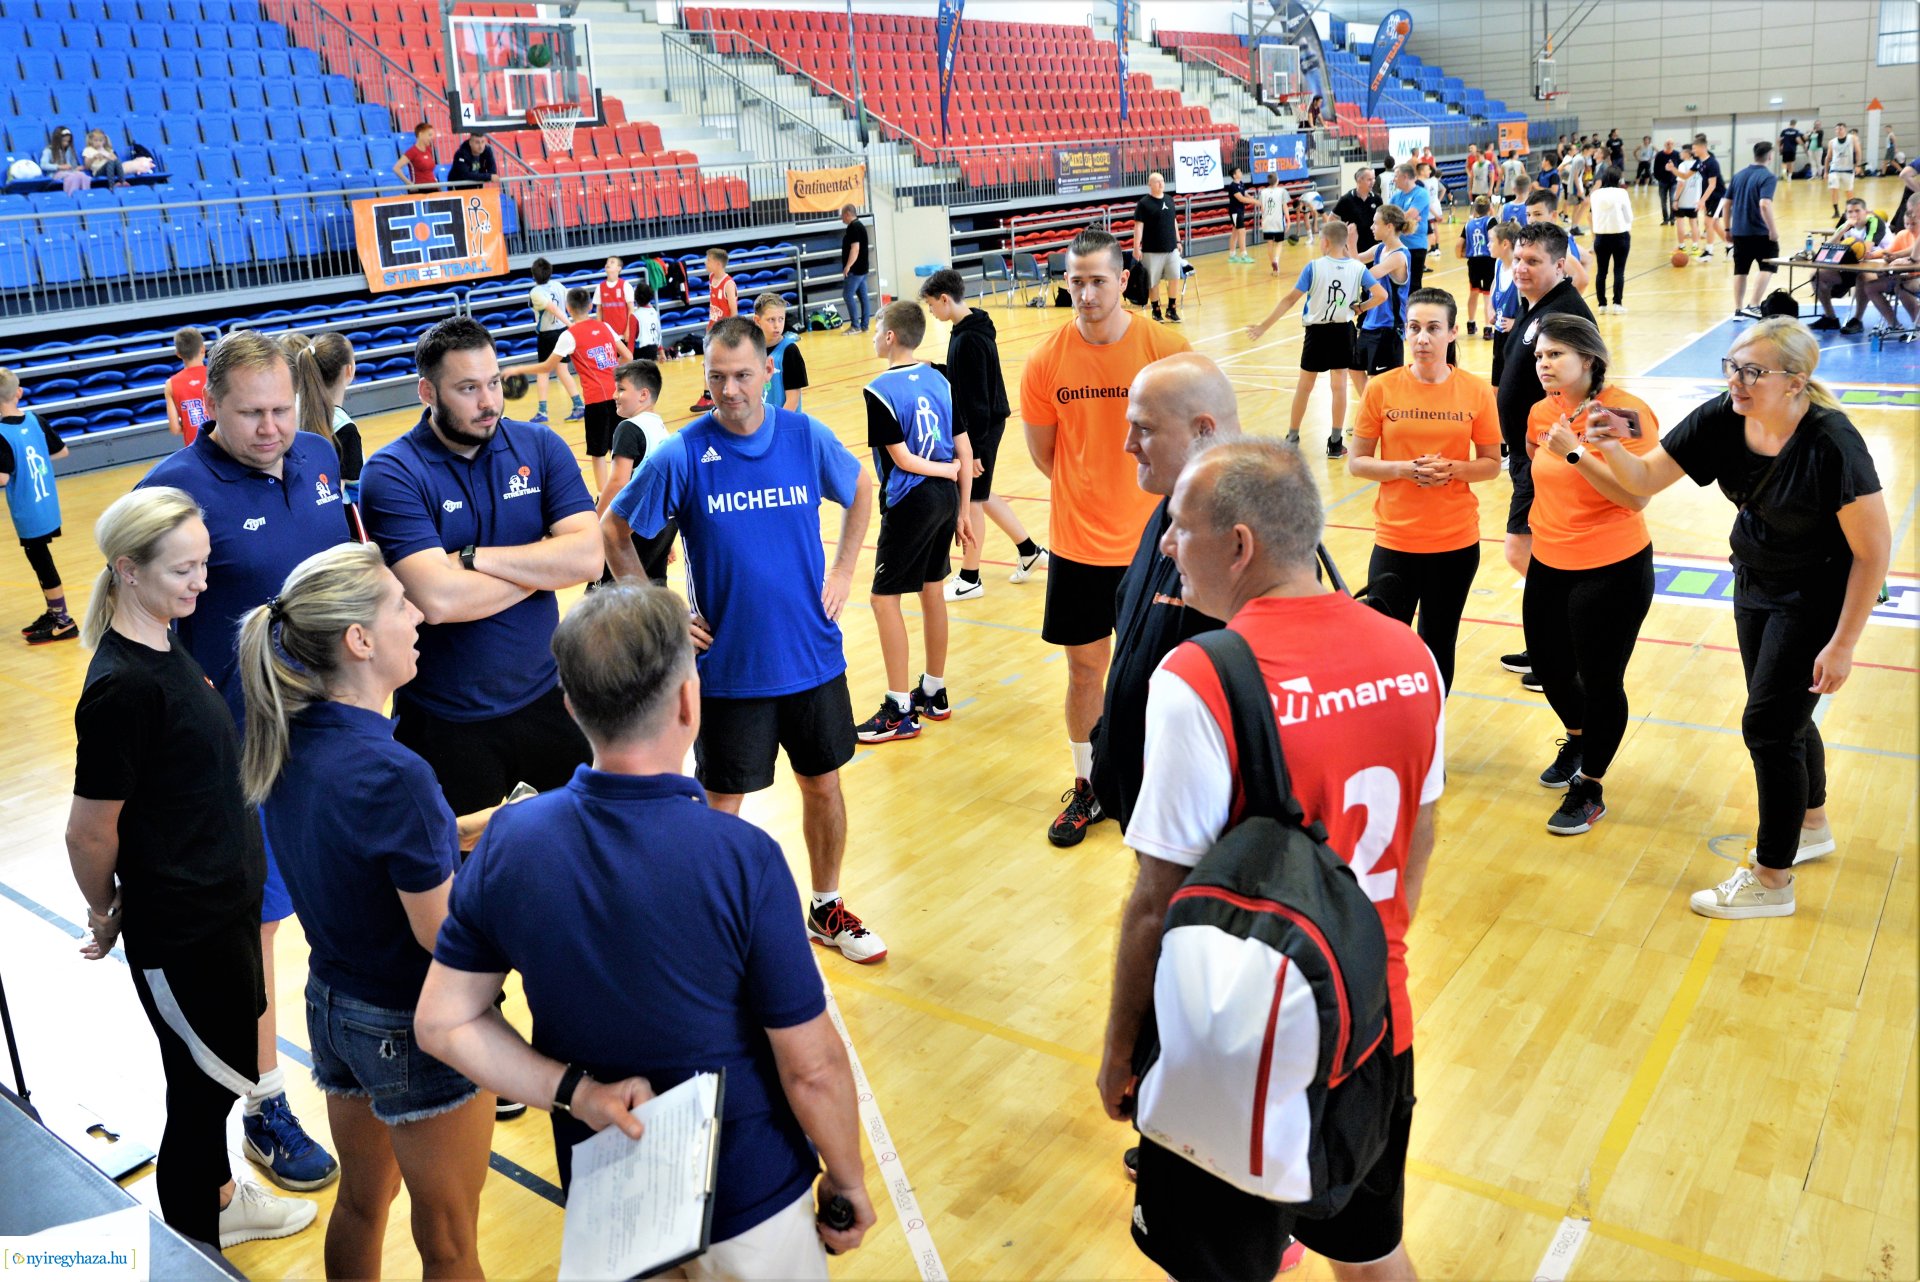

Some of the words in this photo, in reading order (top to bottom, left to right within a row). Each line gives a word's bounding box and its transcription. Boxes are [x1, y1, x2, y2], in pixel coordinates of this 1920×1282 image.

[463, 107, 471, 119] 4
[1180, 155, 1211, 166] POWER
[1192, 166, 1209, 177] ADE
[794, 176, 853, 199] Continental
[1057, 385, 1129, 405] Continenta
[1386, 408, 1463, 422] Continental
[701, 455, 722, 463] adidas
[503, 486, 541, 500] STREETBALL
[707, 485, 808, 514] MICHELIN
[1316, 671, 1430, 718] marso
[1343, 765, 1400, 903] 2
